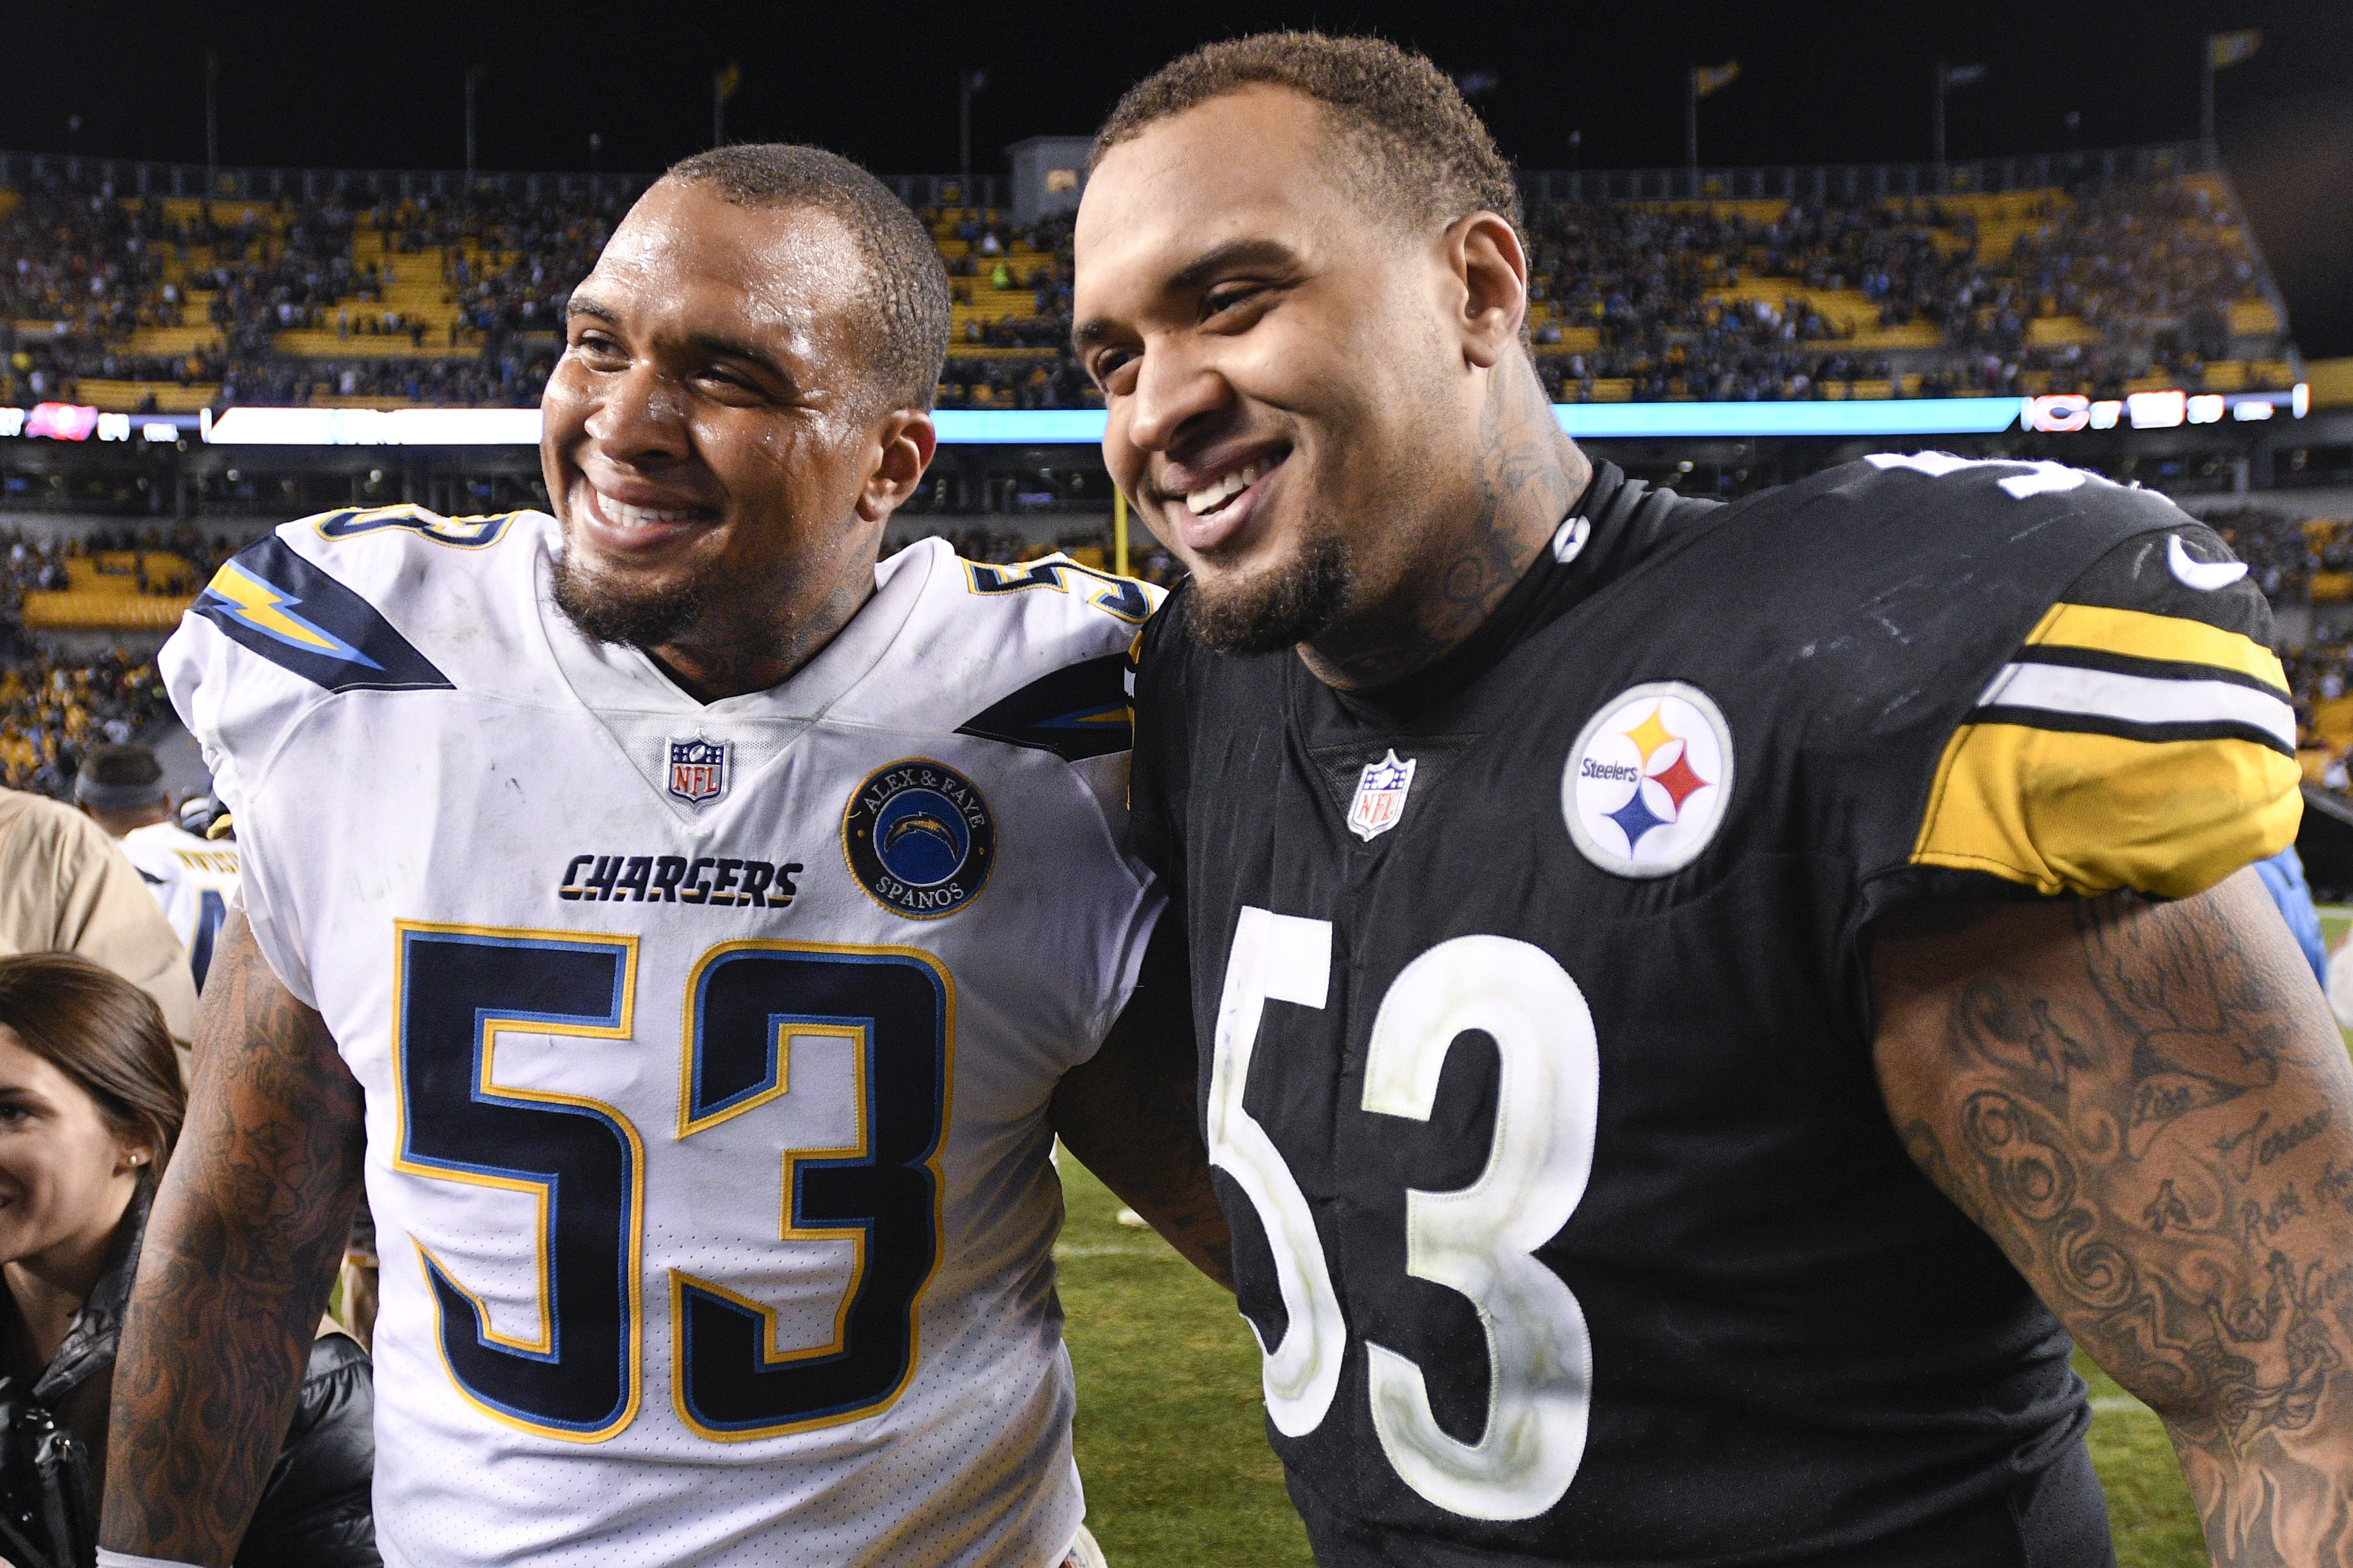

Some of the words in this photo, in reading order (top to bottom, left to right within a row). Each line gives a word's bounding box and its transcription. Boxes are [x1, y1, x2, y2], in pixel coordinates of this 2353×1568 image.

[673, 765, 717, 796] NFL
[1581, 757, 1638, 782] Steelers
[864, 769, 917, 814] ALEX
[920, 770, 938, 787] &
[940, 777, 985, 828] FAYE
[1357, 793, 1395, 825] NFL
[559, 855, 803, 908] CHARGERS
[876, 876, 964, 909] SPANOS
[392, 918, 955, 1442] 53
[1208, 906, 1600, 1521] 53
